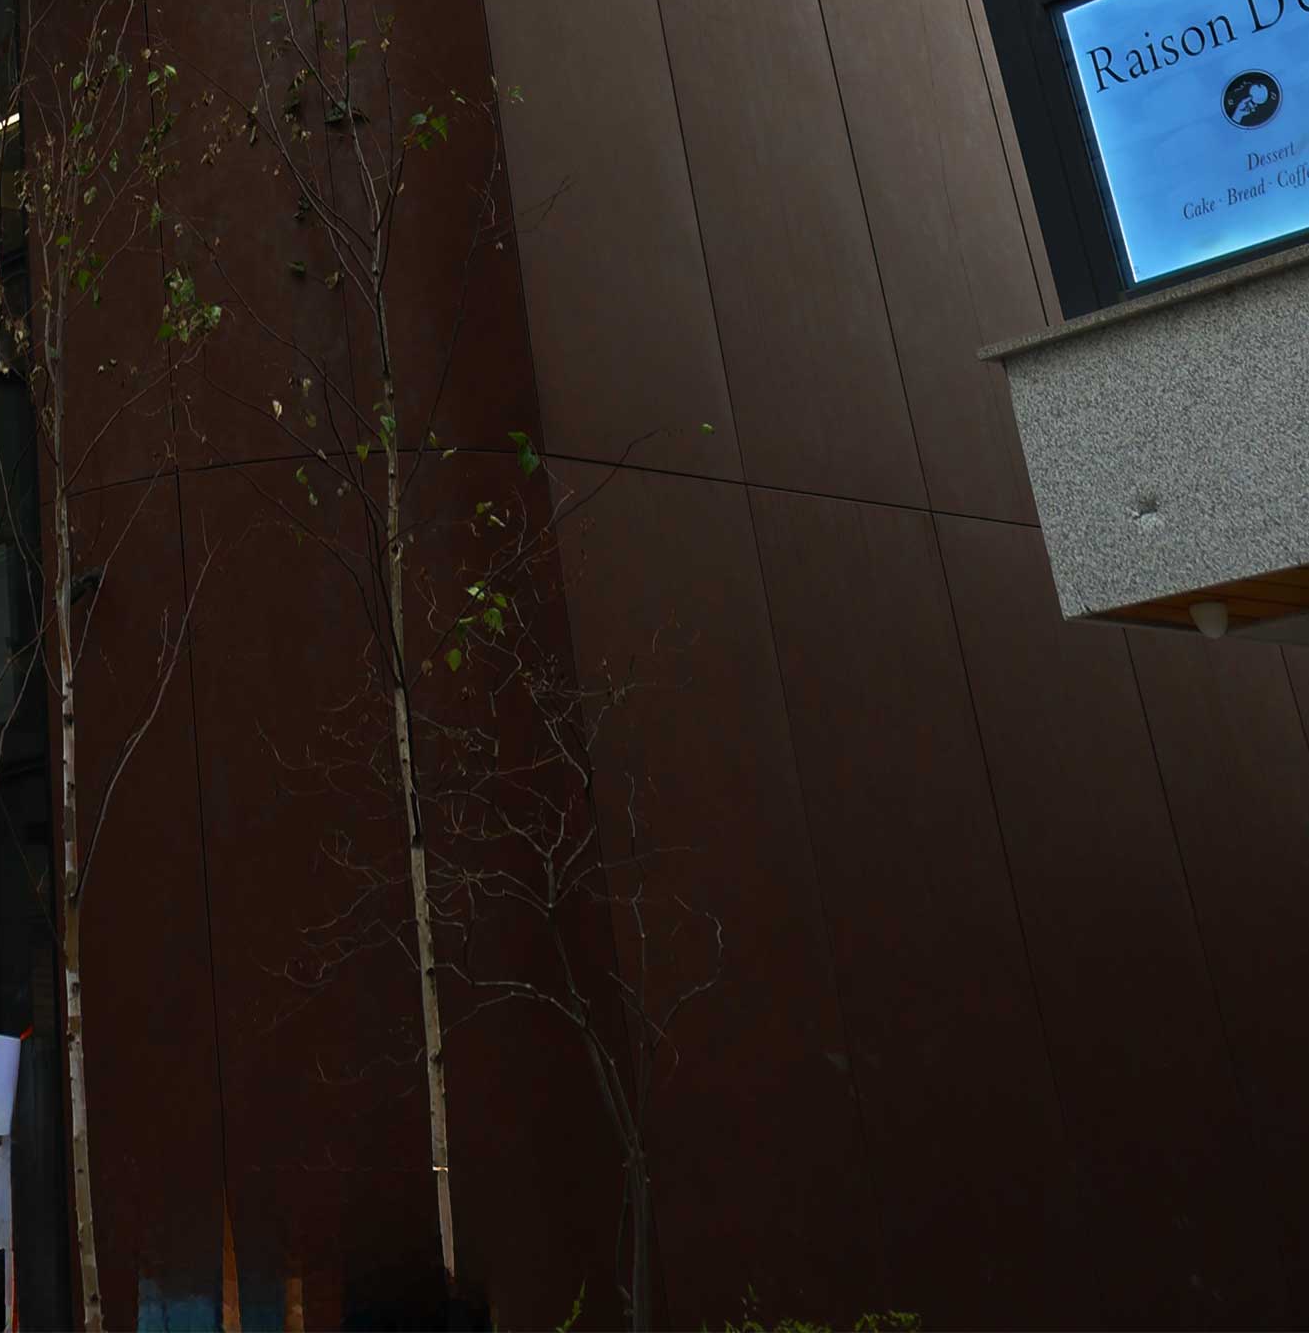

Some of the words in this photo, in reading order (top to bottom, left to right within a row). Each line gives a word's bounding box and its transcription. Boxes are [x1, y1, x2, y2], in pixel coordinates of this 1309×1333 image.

[1086, 14, 1238, 93] Raison
[1246, 141, 1296, 170] Dessert
[1183, 197, 1216, 220] Cake
[1227, 177, 1266, 206] Bread
